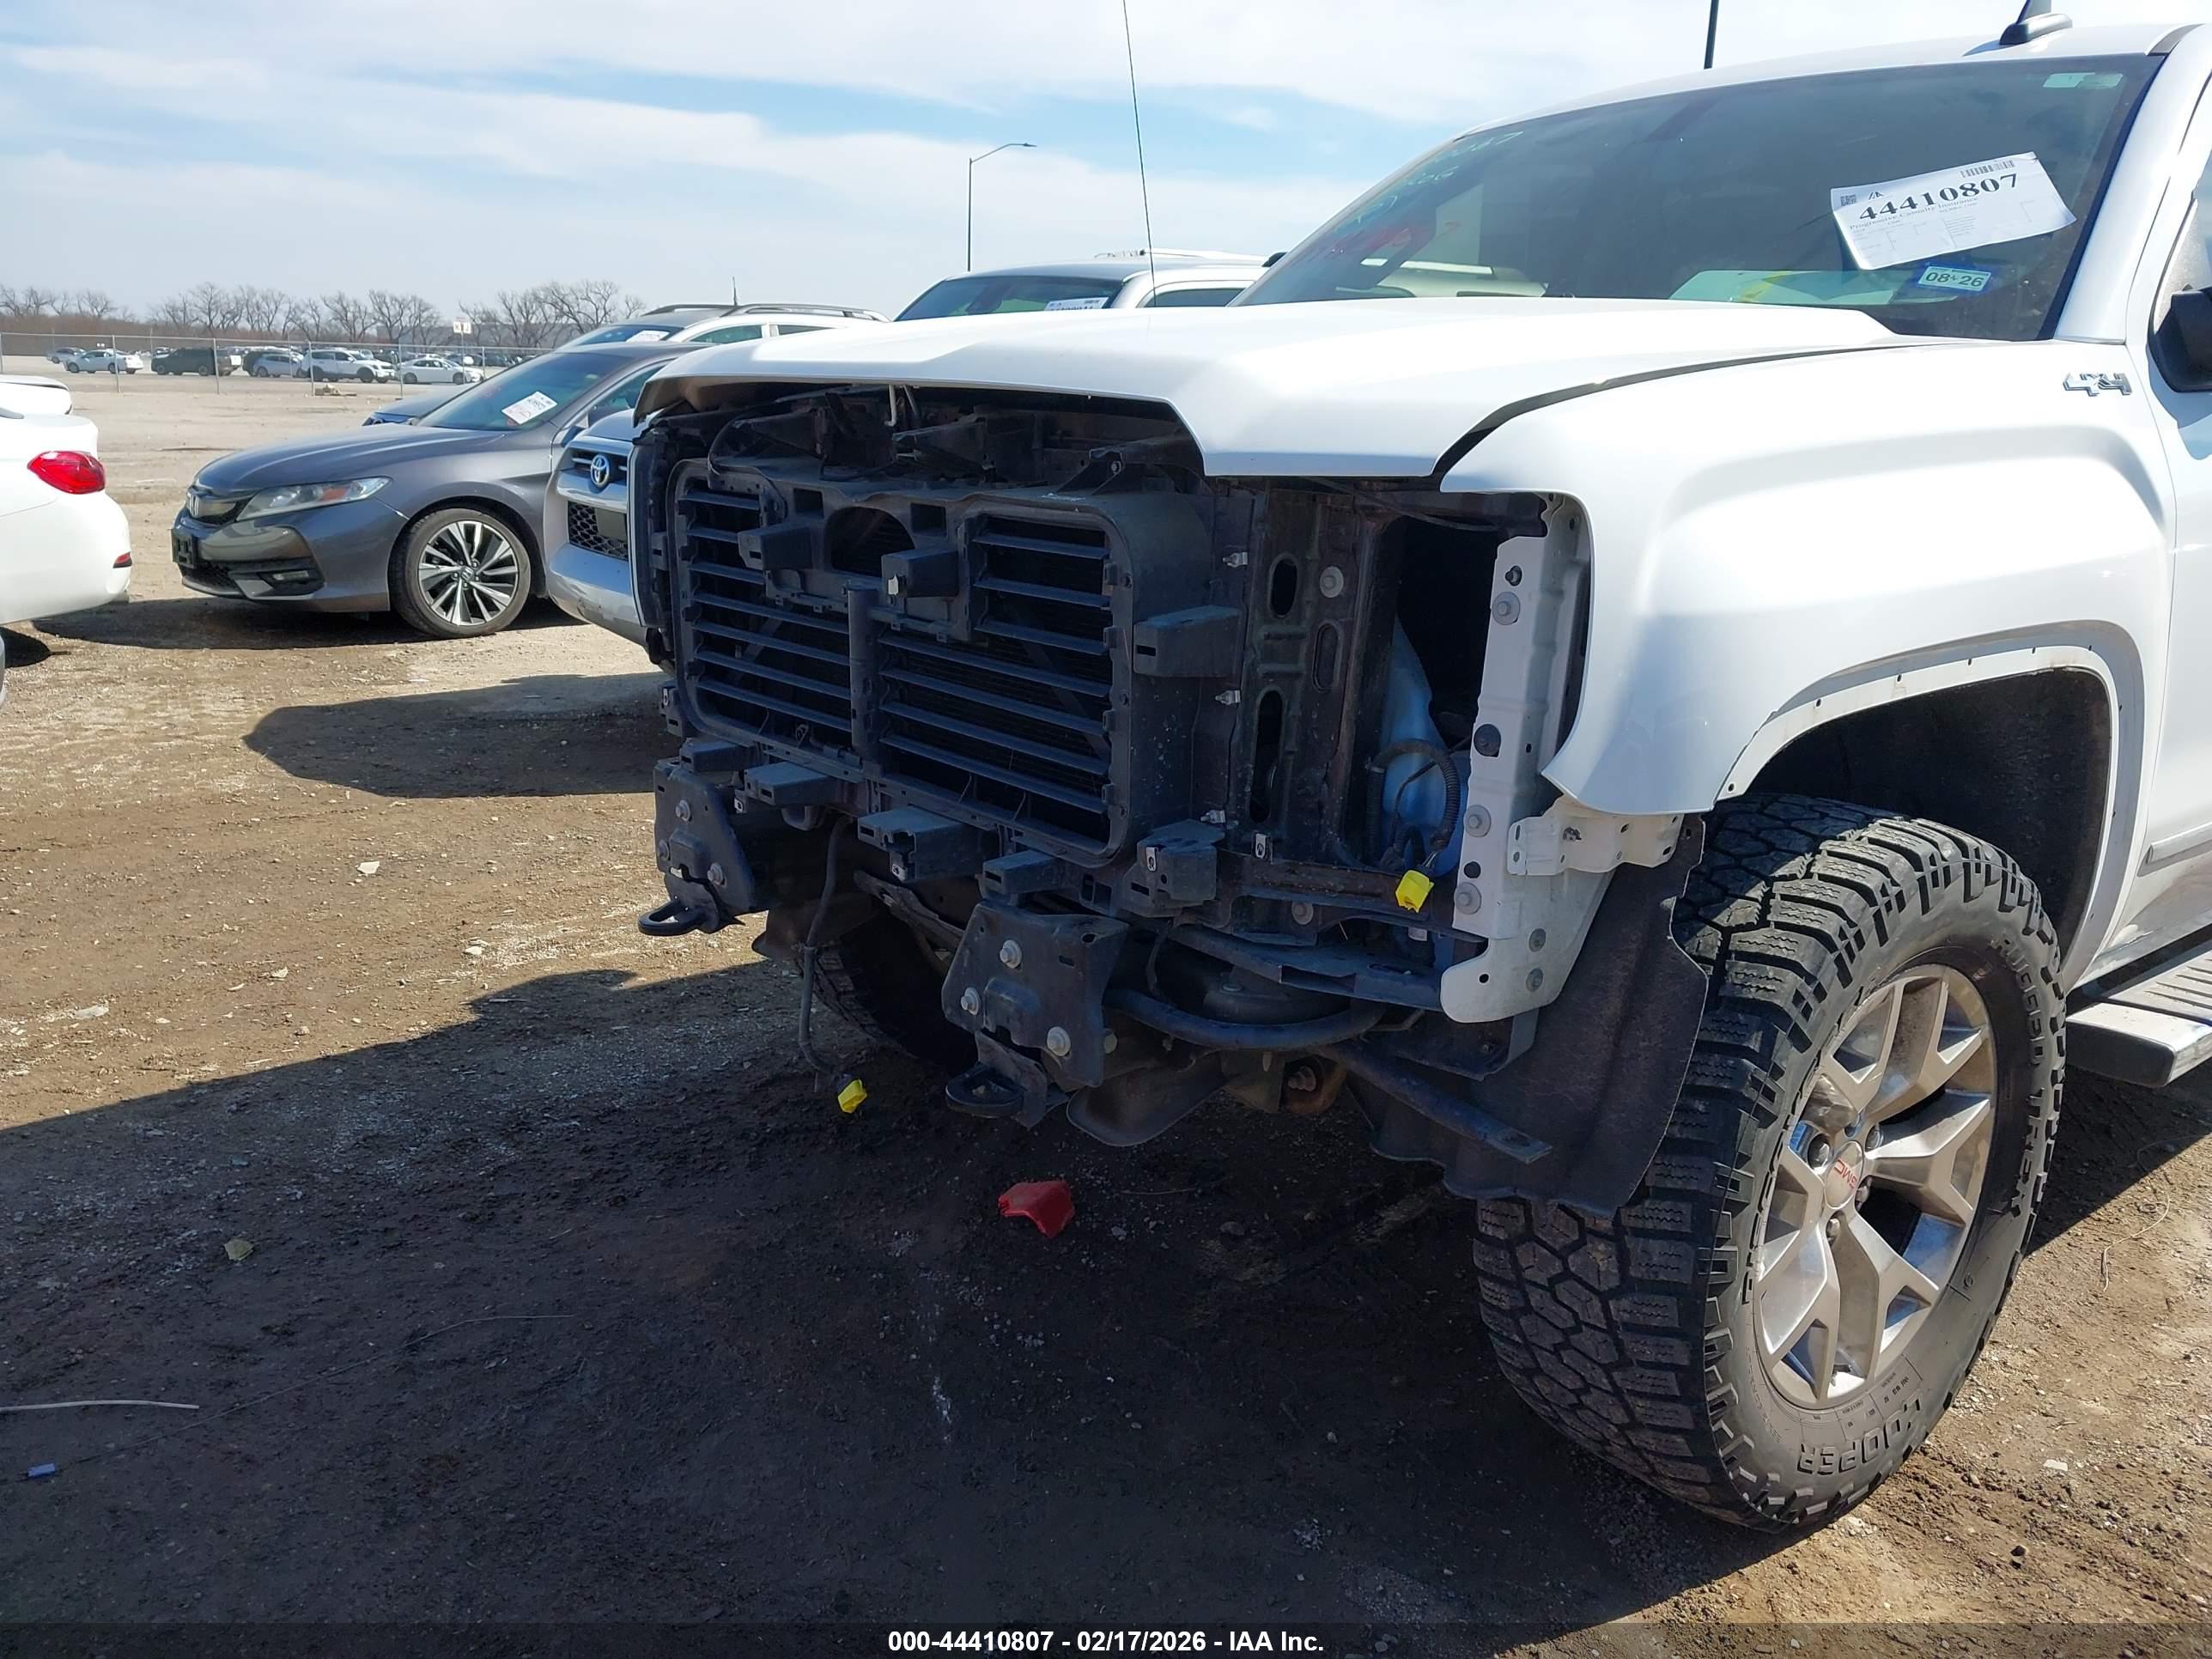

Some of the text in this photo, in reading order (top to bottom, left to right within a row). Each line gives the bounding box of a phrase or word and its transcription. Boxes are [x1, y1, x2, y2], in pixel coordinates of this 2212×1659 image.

[1859, 173, 2018, 221] 44410807
[1925, 271, 1985, 288] 08 26
[1988, 933, 2046, 1218] RUGGED TREK
[1833, 1158, 1858, 1189] GMC
[1796, 1390, 1923, 1476] COOPER
